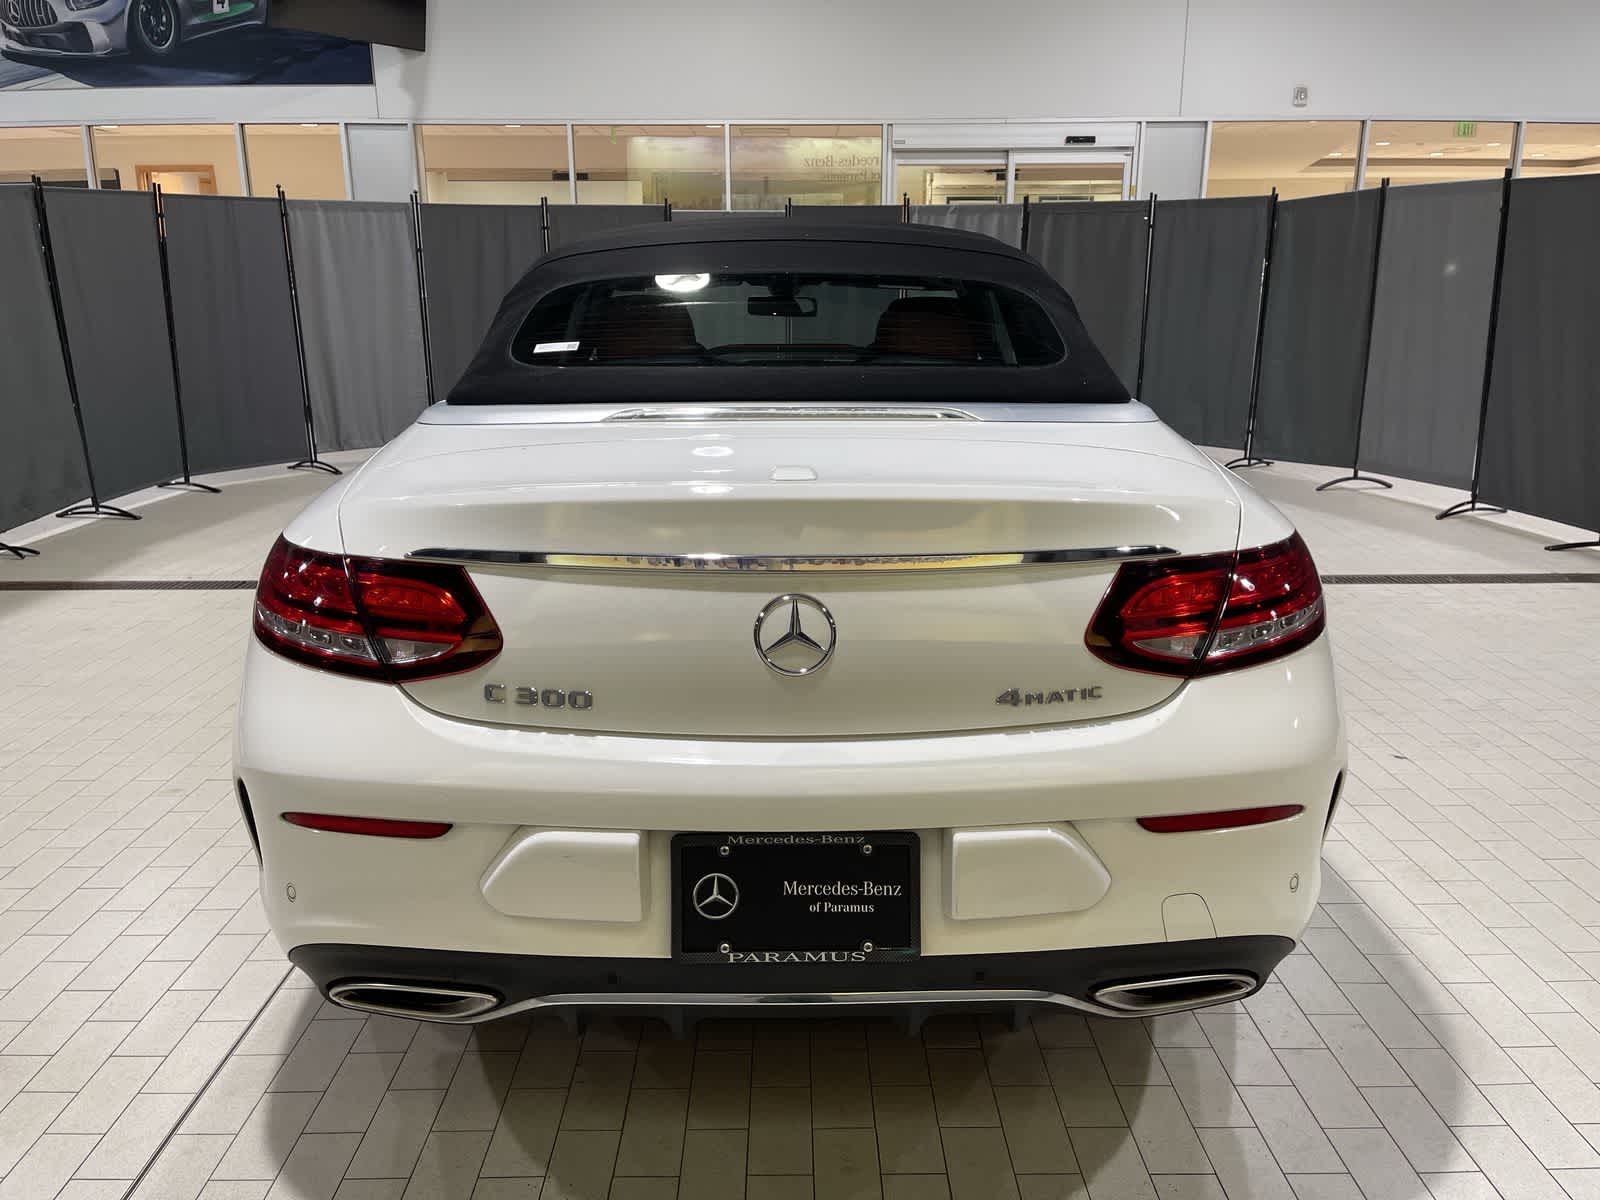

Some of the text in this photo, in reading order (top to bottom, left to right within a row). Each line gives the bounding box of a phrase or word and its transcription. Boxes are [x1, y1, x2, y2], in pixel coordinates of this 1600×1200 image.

[484, 684, 593, 709] C 300
[995, 685, 1103, 706] 4MATIC
[727, 835, 866, 845] Mercedes-Benz
[783, 880, 902, 897] Mercedes-Benz
[809, 902, 875, 913] of Paramus
[728, 951, 866, 963] PARAMUS
